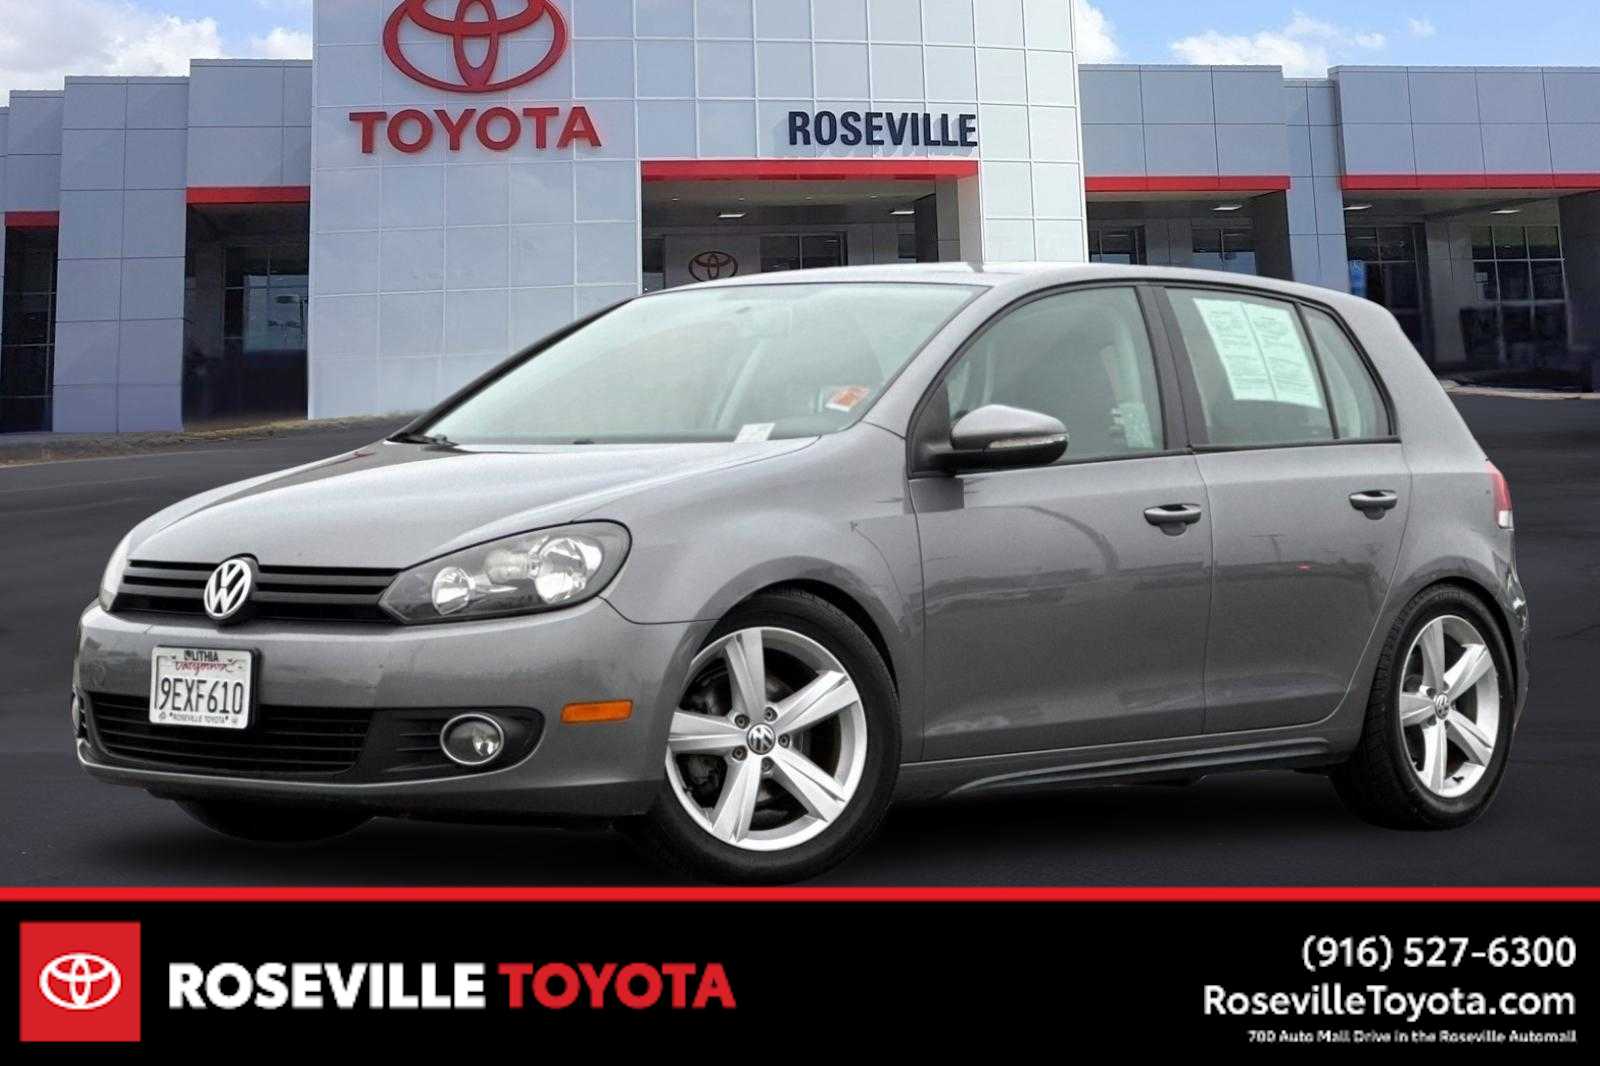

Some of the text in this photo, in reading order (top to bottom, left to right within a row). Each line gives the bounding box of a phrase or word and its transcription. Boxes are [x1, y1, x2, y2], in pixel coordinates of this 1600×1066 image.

[350, 106, 602, 154] TOYOTA
[788, 111, 978, 147] ROSEVILLE
[159, 677, 244, 714] 9EXF610
